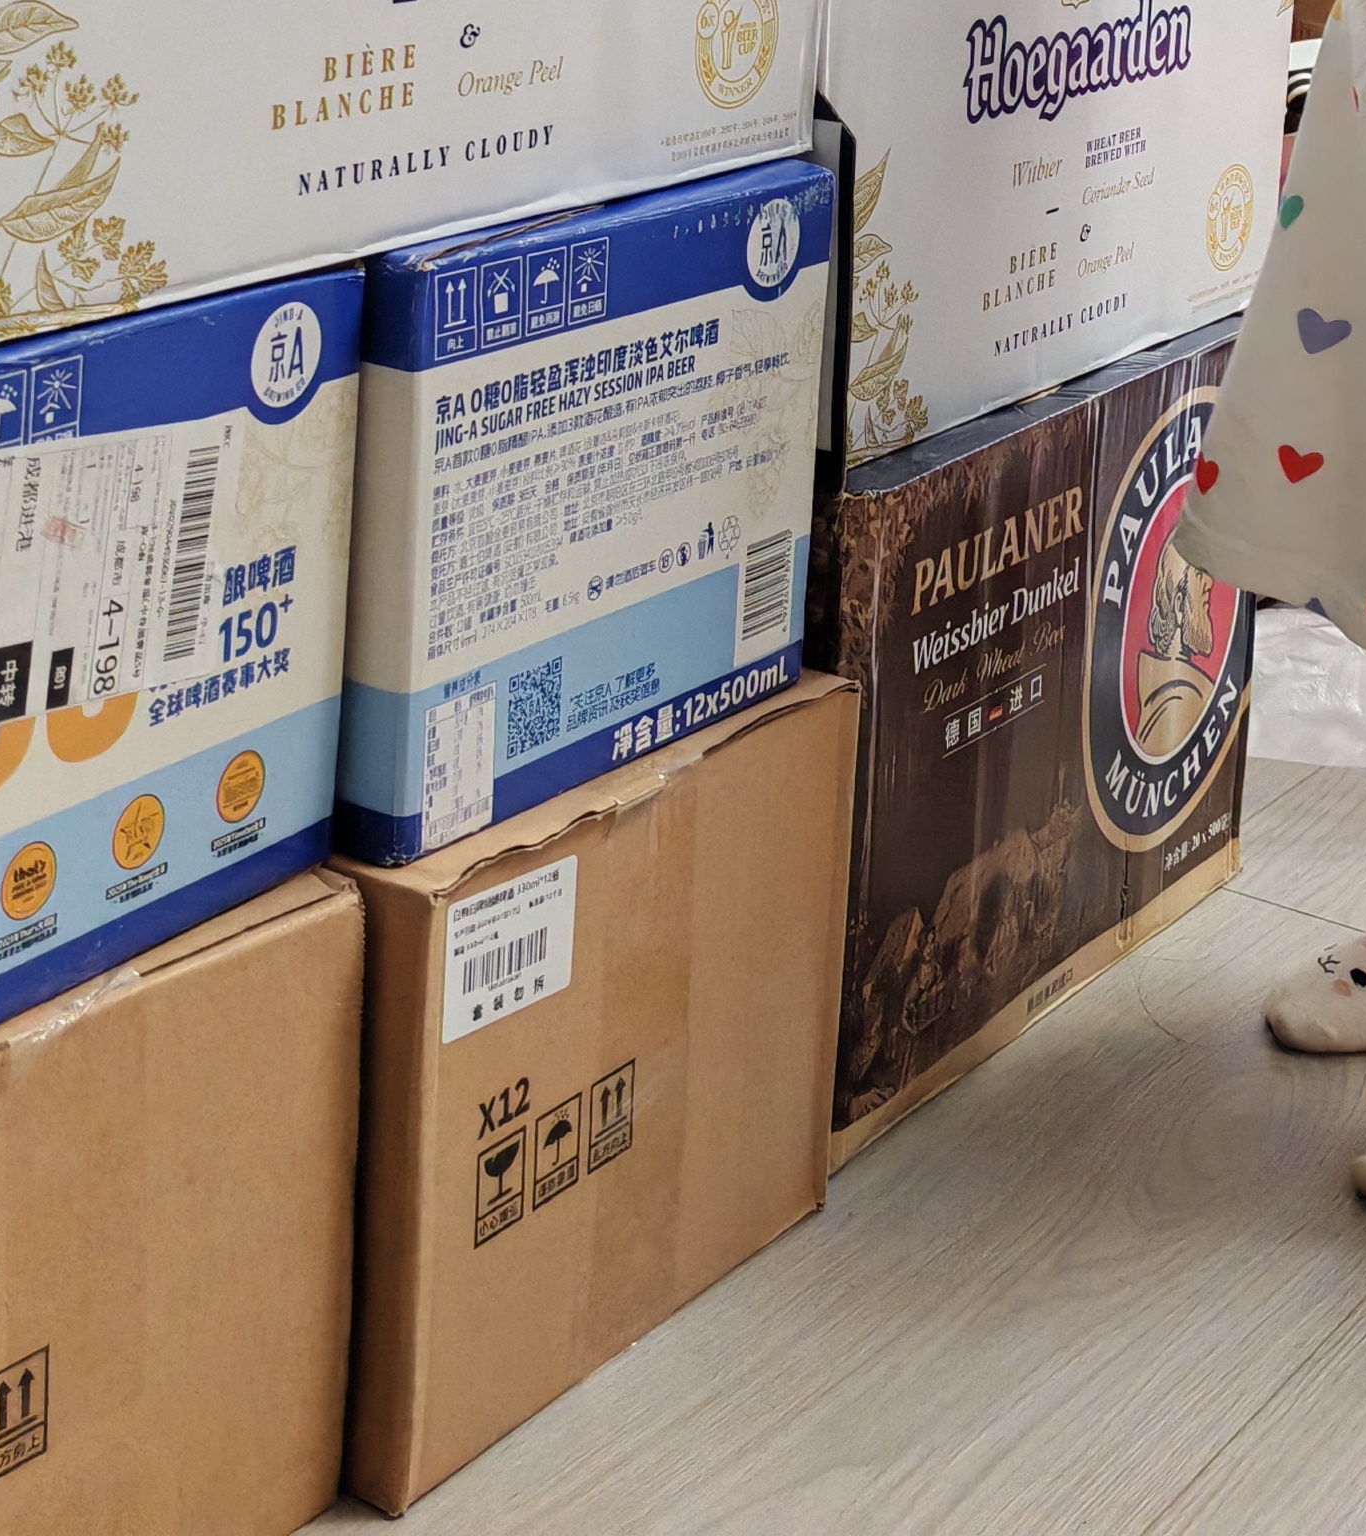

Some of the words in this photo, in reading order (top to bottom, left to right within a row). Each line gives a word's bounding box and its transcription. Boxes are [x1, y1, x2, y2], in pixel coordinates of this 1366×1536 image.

[323, 42, 417, 83] BIÈRE
[459, 23, 481, 48] &
[457, 70, 524, 98] Orange
[528, 56, 565, 86] Peel
[271, 81, 416, 131] BLANCHE
[298, 145, 452, 196] NATURALLY
[465, 124, 555, 162] CLOUDY
[1084, 145, 1122, 169] BREWED
[1123, 138, 1147, 159] WITH
[1086, 132, 1117, 152] WHEAT
[1119, 126, 1142, 146] BEER
[1012, 153, 1063, 190] Witbier
[1082, 175, 1132, 206] Coriander
[1133, 167, 1156, 191] Seed
[1080, 224, 1092, 242] &
[982, 269, 1057, 312] BLANCHE
[1077, 252, 1113, 278] Orange
[446, 336, 465, 352] 向上
[993, 312, 1074, 357] NATURALLY
[1080, 292, 1129, 324] CLOUDY
[268, 326, 304, 383] 京A
[435, 393, 466, 425] 京A
[471, 318, 720, 413] 0糖0脂轻盈浑浊印度淡色艾尔啤酒
[435, 424, 477, 455] JING-A
[481, 406, 522, 437] SUGAR
[526, 397, 556, 423] FREE
[560, 385, 592, 411] HAZY
[594, 370, 642, 402] SESSION
[646, 365, 663, 386] IPA
[668, 355, 696, 379] BEER
[223, 544, 297, 607] 酿啤酒
[911, 485, 1085, 618] PAULANER
[912, 603, 1010, 676] Weissbier
[1011, 557, 1082, 627] Dunkel
[93, 598, 125, 698] 4-198
[148, 647, 292, 727] 全球啤酒赛事大奖
[945, 706, 983, 750] 德国
[1008, 674, 1043, 715] 进口
[1104, 675, 1238, 818] MÜNCHEN
[478, 1076, 531, 1141] X12
